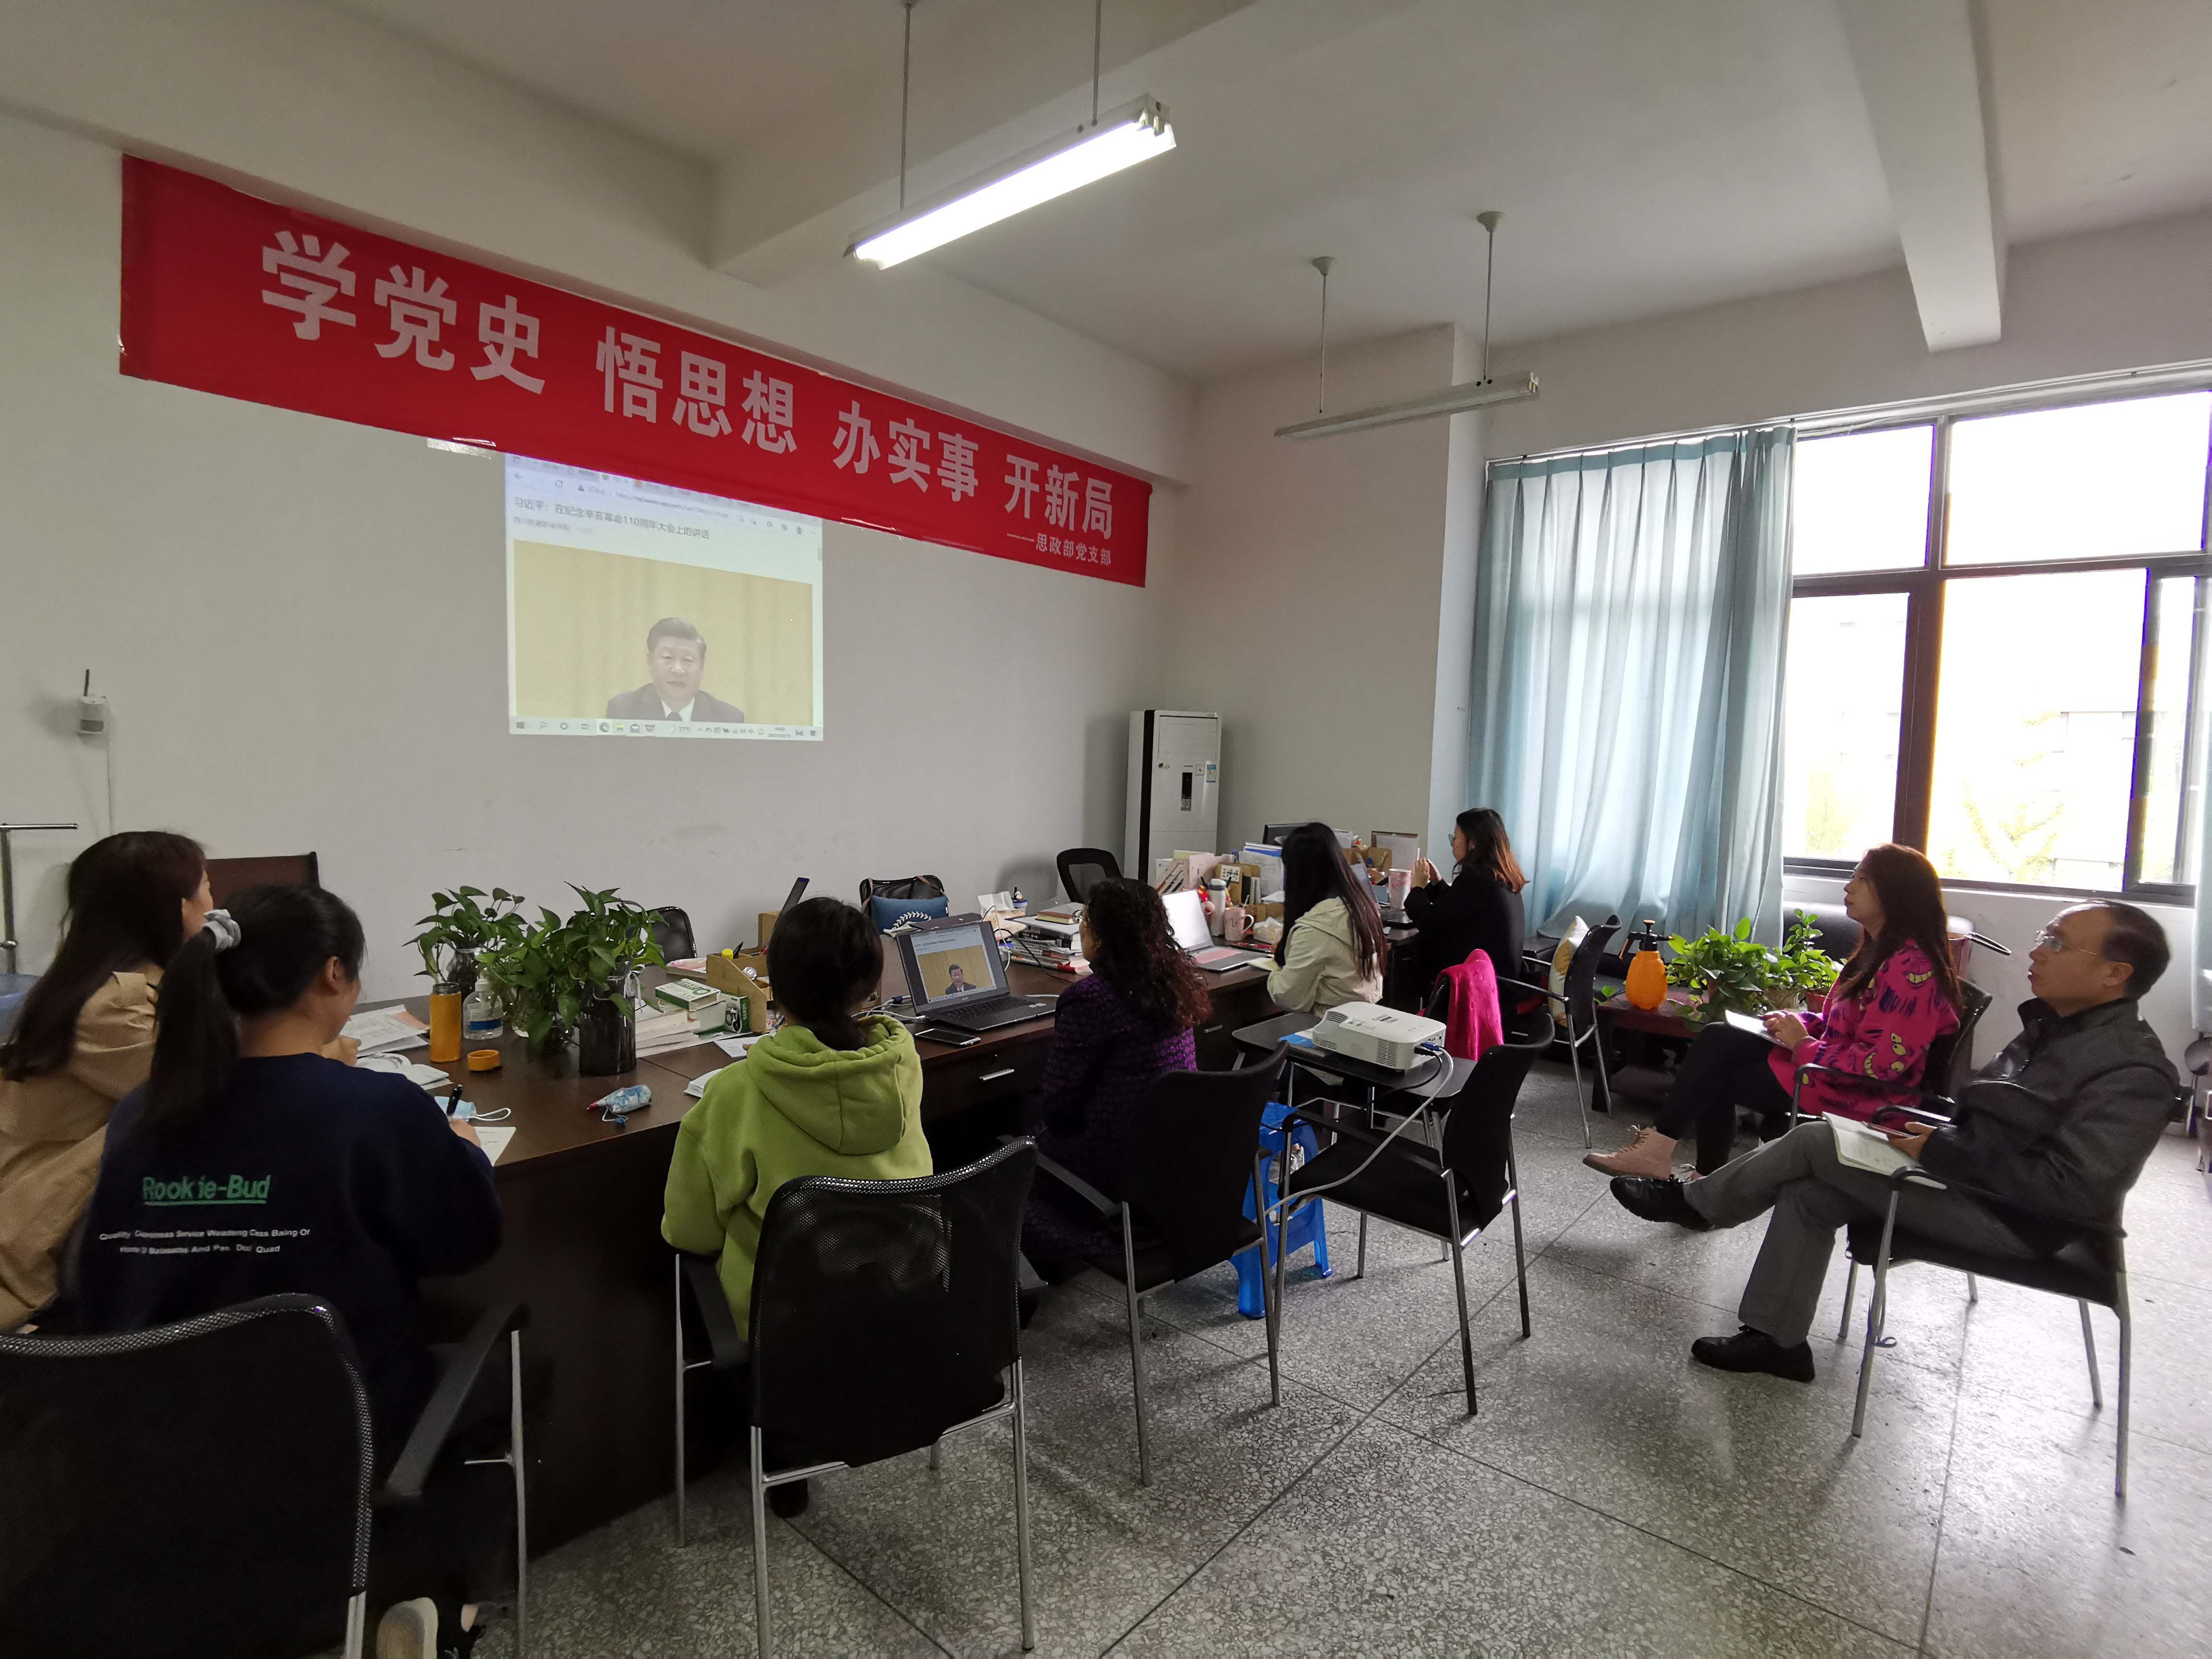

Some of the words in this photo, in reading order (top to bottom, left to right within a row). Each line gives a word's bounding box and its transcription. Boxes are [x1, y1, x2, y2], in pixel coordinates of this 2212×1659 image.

[261, 231, 545, 395] 学党史
[596, 327, 797, 455] 悟思想
[832, 400, 979, 502] 办实事
[1004, 454, 1113, 541] 开新局
